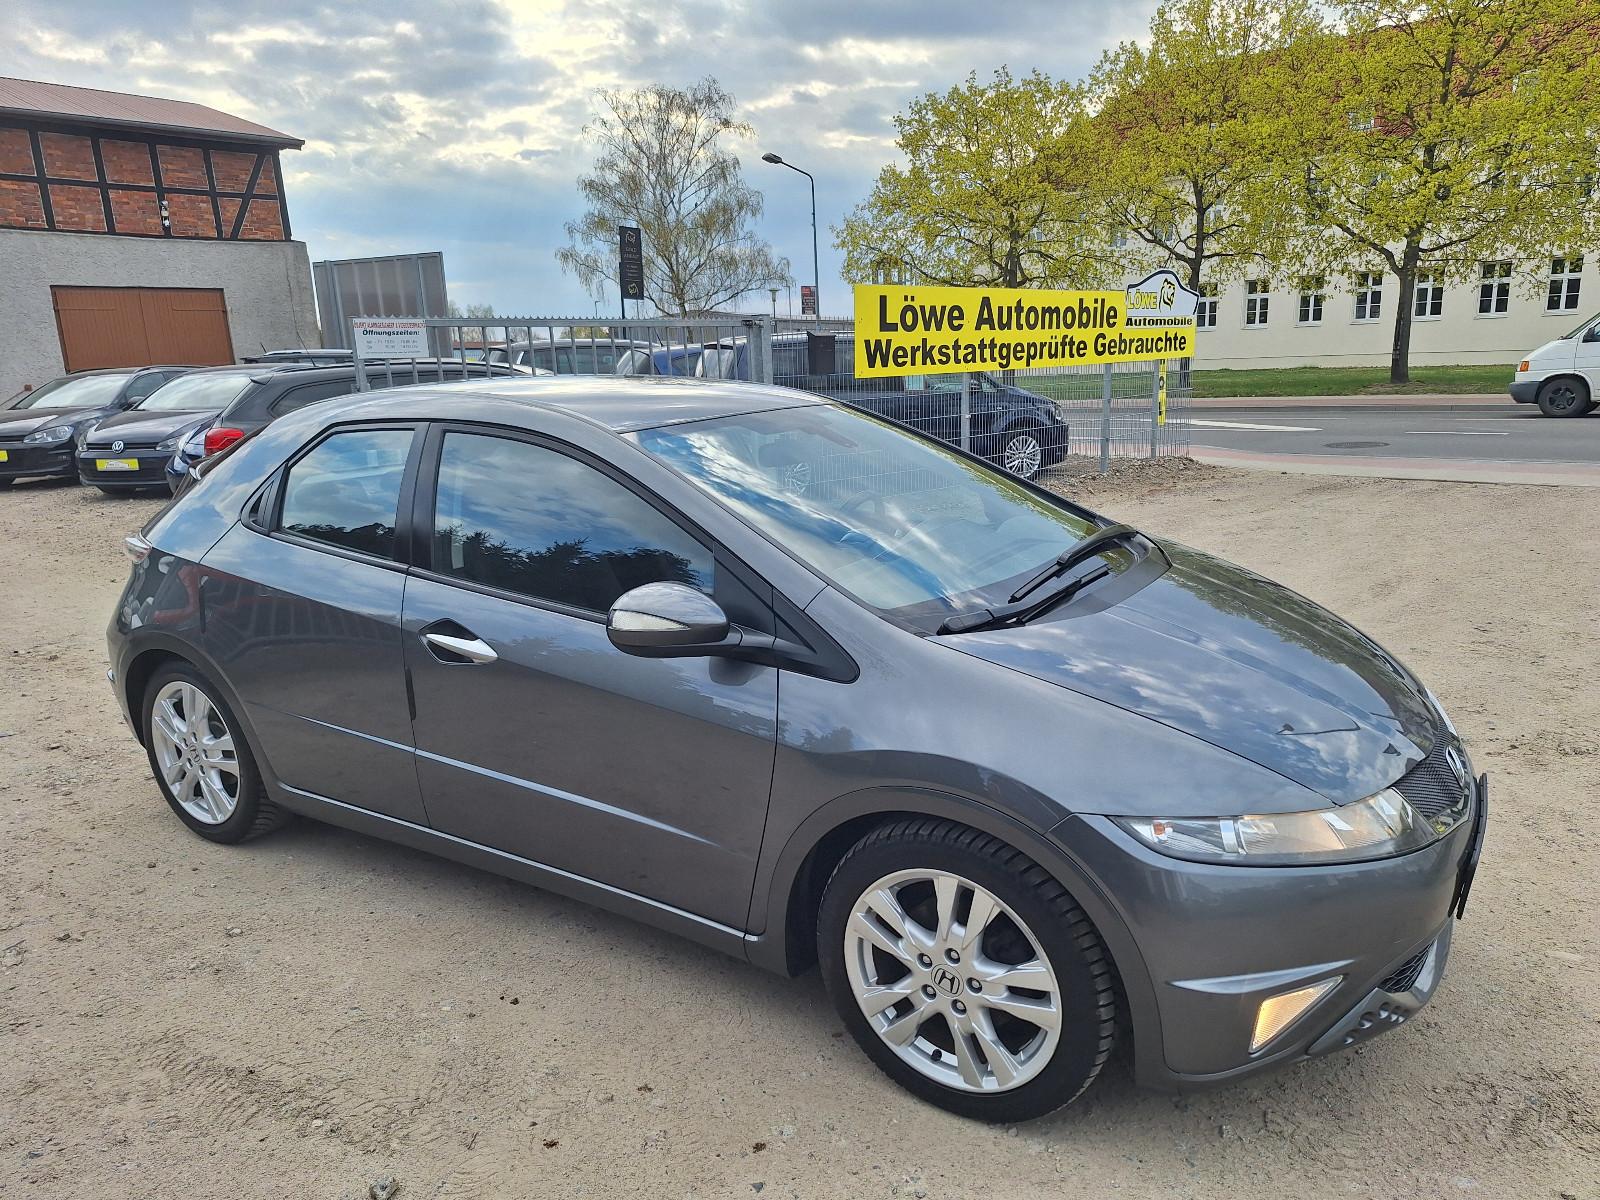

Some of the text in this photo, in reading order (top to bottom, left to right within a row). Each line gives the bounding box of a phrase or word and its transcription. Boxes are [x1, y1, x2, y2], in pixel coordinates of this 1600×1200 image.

[1127, 288, 1158, 310] LÖWE
[879, 295, 1118, 332] Löwe Automobile
[1125, 317, 1193, 327] Automobile
[362, 328, 420, 336] Öffnungszeiten:
[864, 331, 1187, 369] Werkstattgeprüfte Gebrauchte
